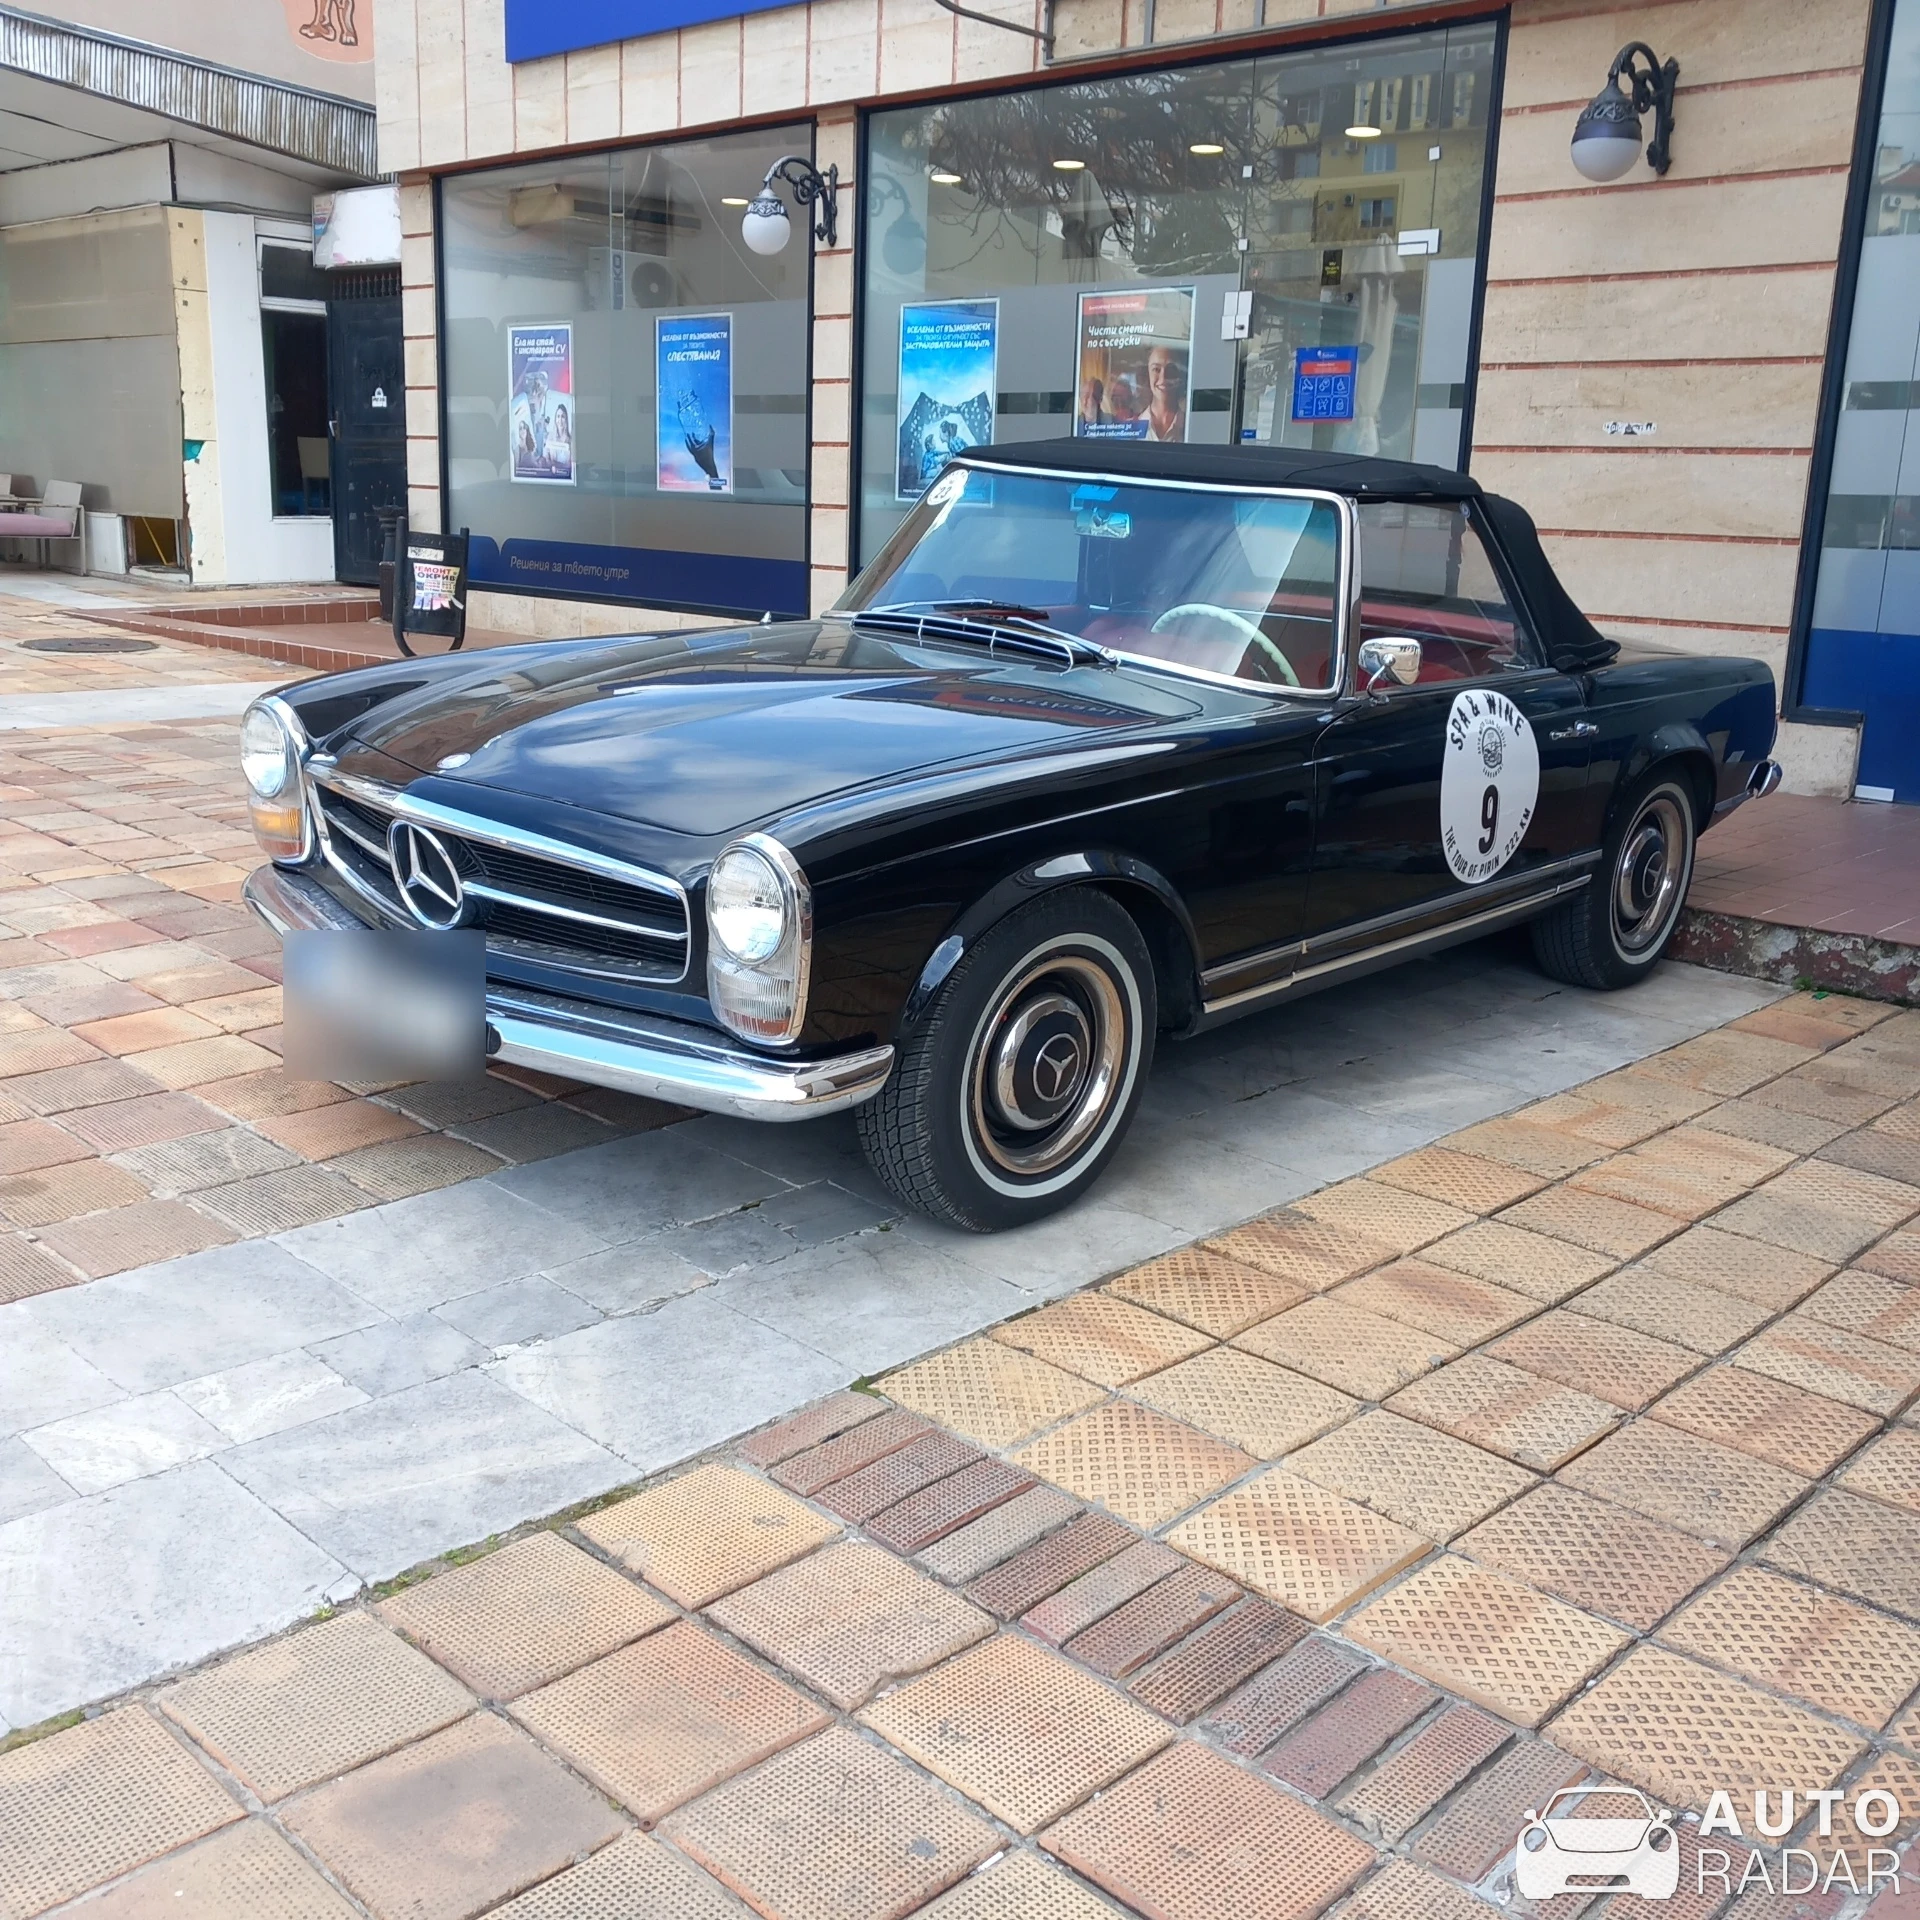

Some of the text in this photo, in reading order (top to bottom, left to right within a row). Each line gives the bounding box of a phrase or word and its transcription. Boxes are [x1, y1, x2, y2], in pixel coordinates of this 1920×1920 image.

[907, 322, 991, 334] ВСЕЛЕНА ОТ ВЪЗМОЖНОСТИ
[1088, 322, 1155, 337] Чисти сметки
[514, 335, 555, 347] Ела на стаж
[1087, 335, 1141, 349] по съседски
[519, 346, 554, 356] инстаграм
[555, 343, 567, 354] CV
[667, 349, 721, 362] СПЕСТЯВАНИЯ
[510, 555, 630, 581] Решения за твоето утре
[1451, 692, 1525, 751] SPA & WINE
[1478, 784, 1499, 856] 9
[1445, 807, 1532, 878] THE TOUR OF PIRIN 222 KM
